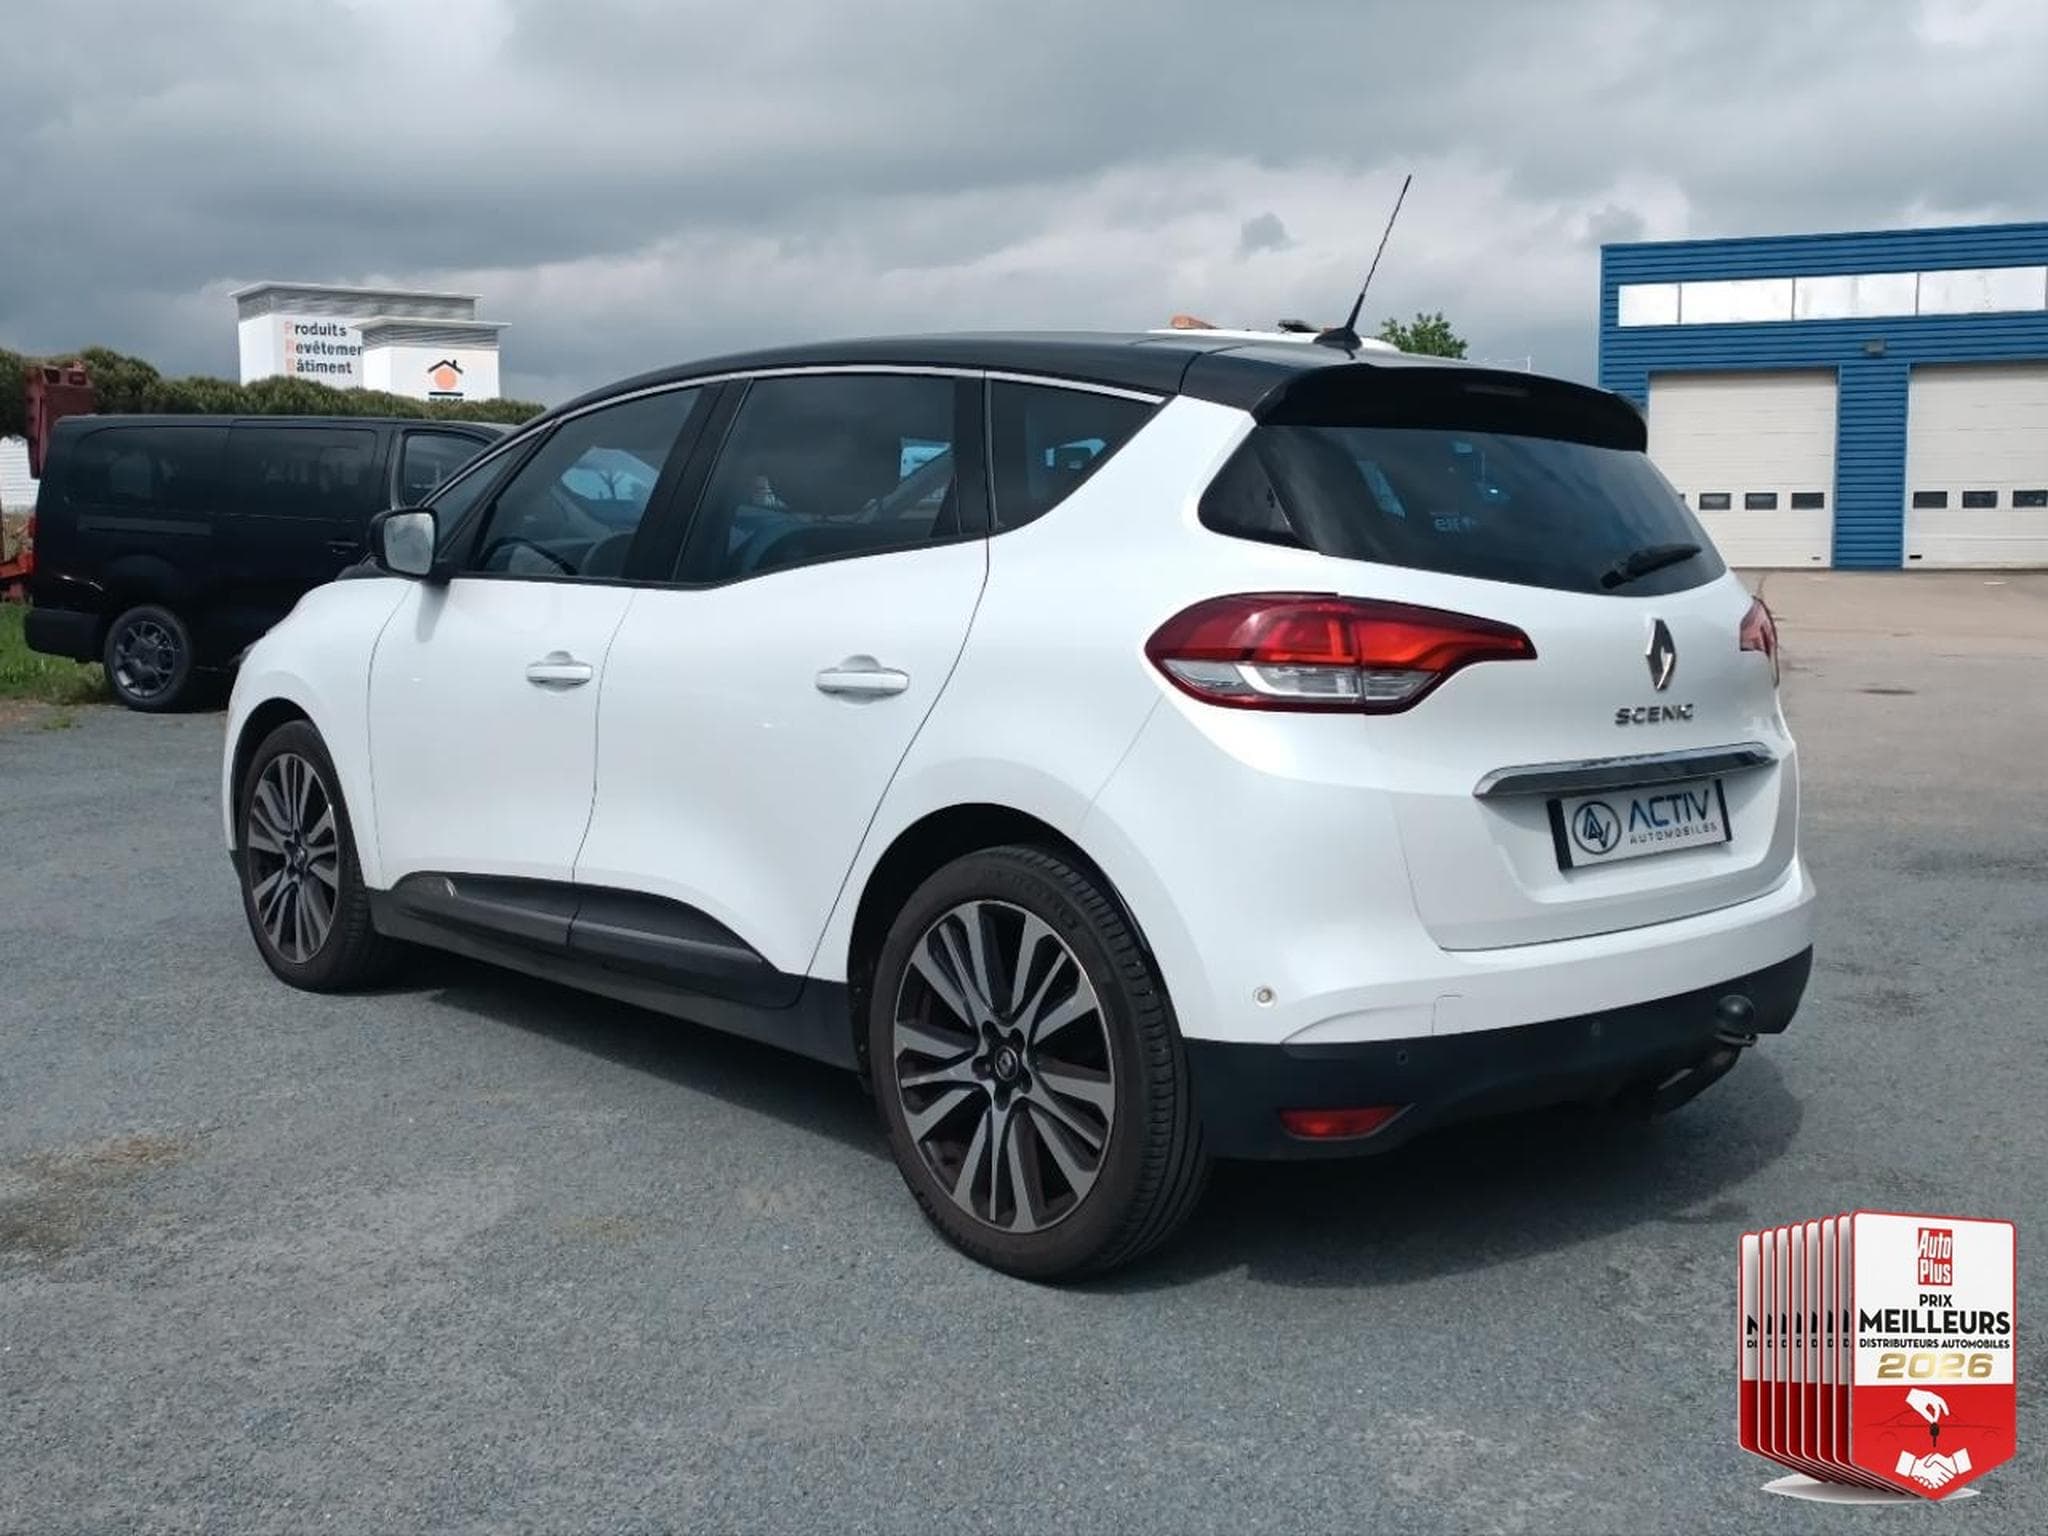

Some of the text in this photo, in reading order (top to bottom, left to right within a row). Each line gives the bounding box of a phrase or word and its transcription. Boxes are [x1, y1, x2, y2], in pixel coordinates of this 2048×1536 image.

[284, 321, 347, 336] Produits
[286, 359, 352, 374] Bâtiment
[1614, 703, 1694, 725] SCENIC
[1628, 789, 1710, 833] ACTIV
[1629, 821, 1718, 845] AUTOMOBILES
